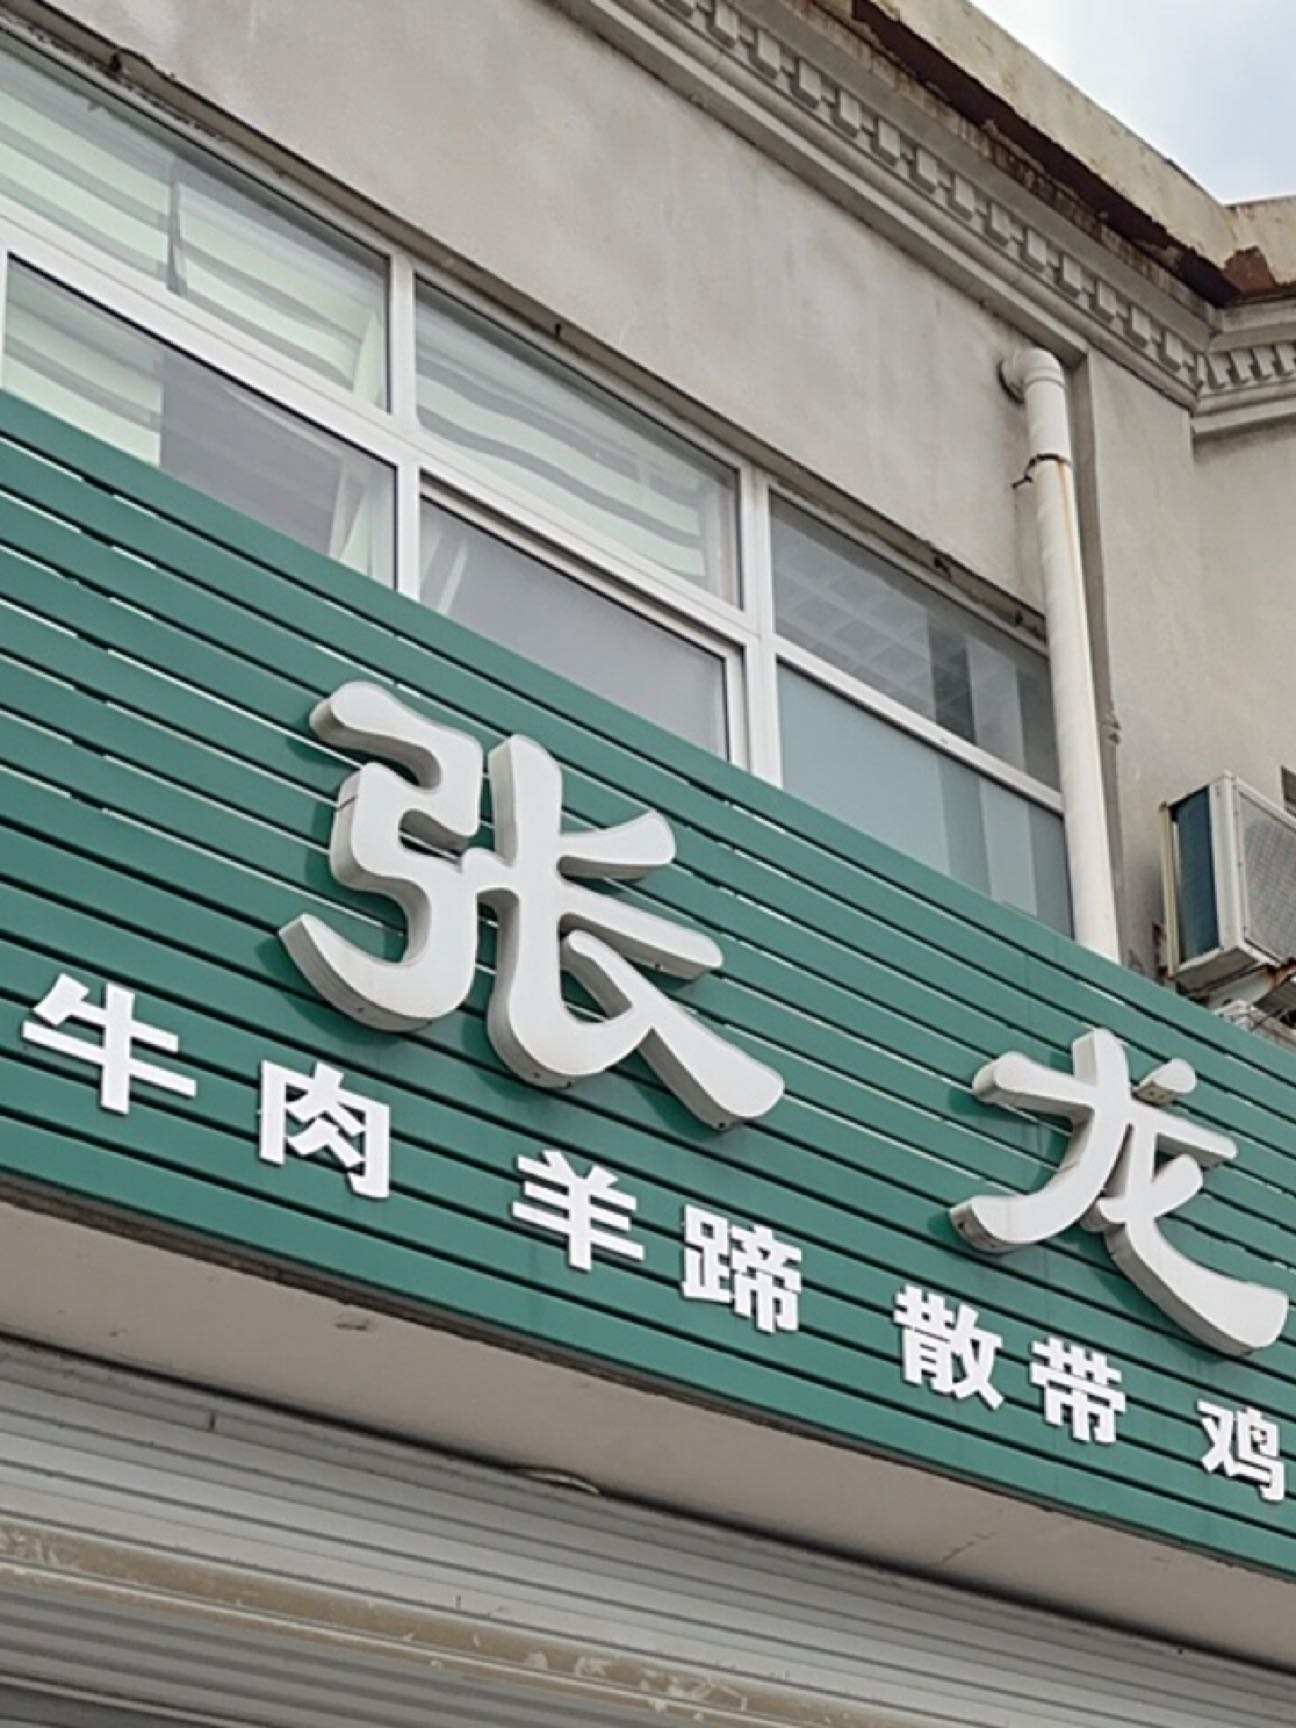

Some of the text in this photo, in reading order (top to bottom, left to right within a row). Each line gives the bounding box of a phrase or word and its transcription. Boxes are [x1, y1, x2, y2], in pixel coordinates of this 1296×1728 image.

[21, 973, 391, 1199] 牛肉
[511, 1150, 803, 1334] 羊蹄
[893, 1284, 1127, 1445] 散带
